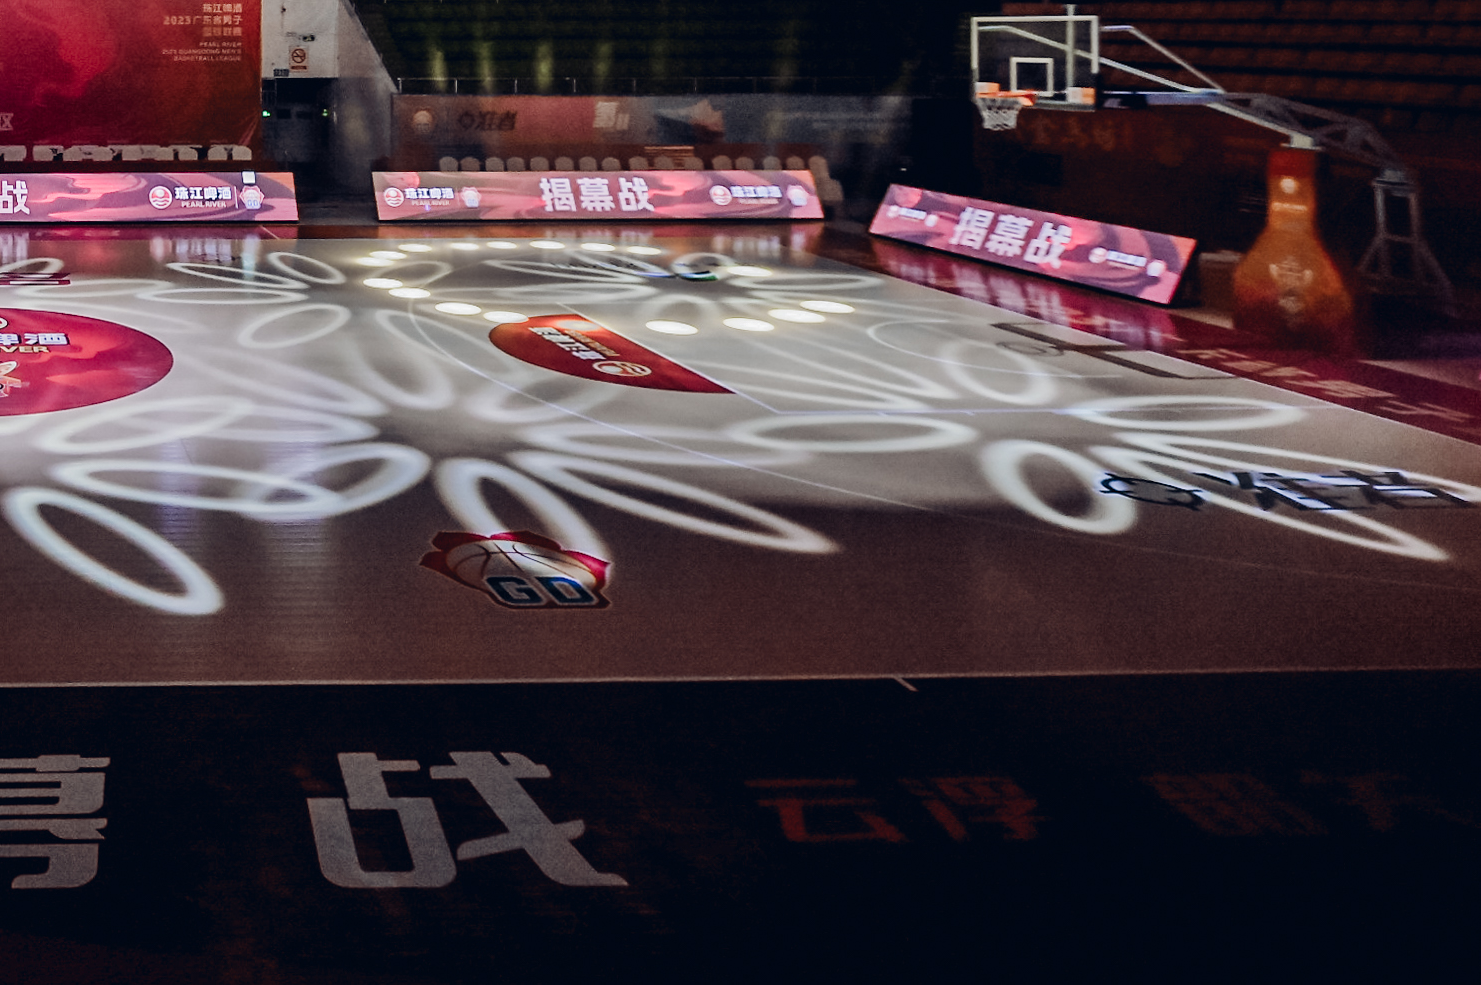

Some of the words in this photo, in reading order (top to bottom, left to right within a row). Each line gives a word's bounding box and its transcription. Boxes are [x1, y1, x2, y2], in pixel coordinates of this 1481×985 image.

[175, 186, 232, 200] 珠江啤酒
[539, 177, 655, 212] 揭幕战
[949, 207, 1072, 269] 揭幕战
[485, 576, 599, 605] GD
